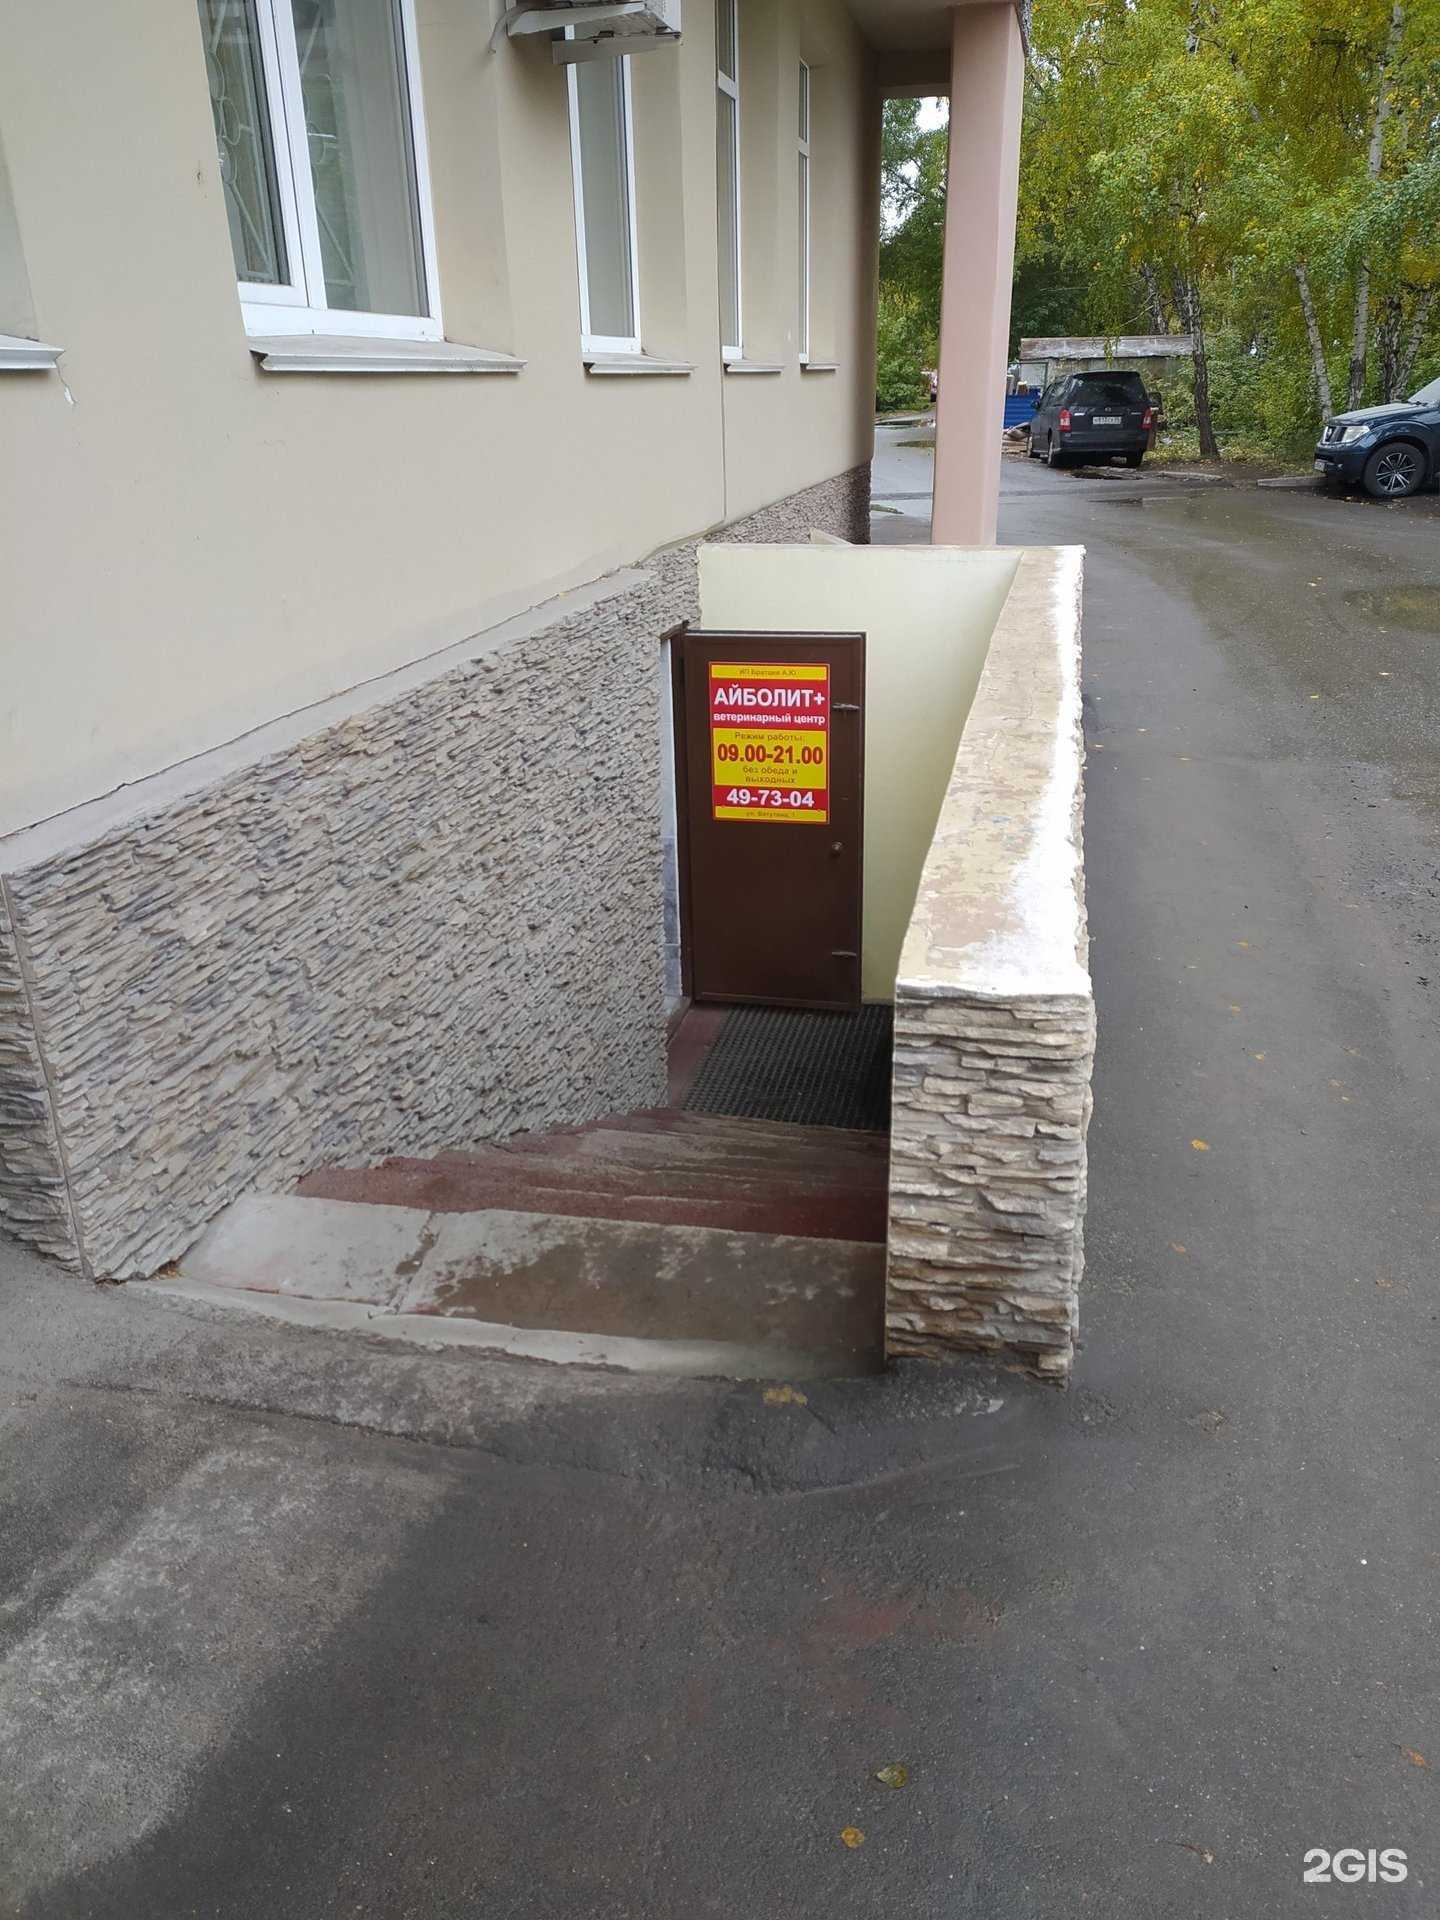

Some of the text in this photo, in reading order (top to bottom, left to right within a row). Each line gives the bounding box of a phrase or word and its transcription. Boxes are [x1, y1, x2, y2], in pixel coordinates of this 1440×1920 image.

[714, 683, 825, 708] АЙБОЛИТ+
[713, 712, 826, 725] ветеринарный центр
[735, 731, 765, 740] Режим
[717, 743, 824, 765] 09.00-21.00
[743, 766, 760, 774] без
[761, 767, 789, 776] обеда
[745, 776, 796, 785] выходных
[726, 788, 815, 807] 49-73-04
